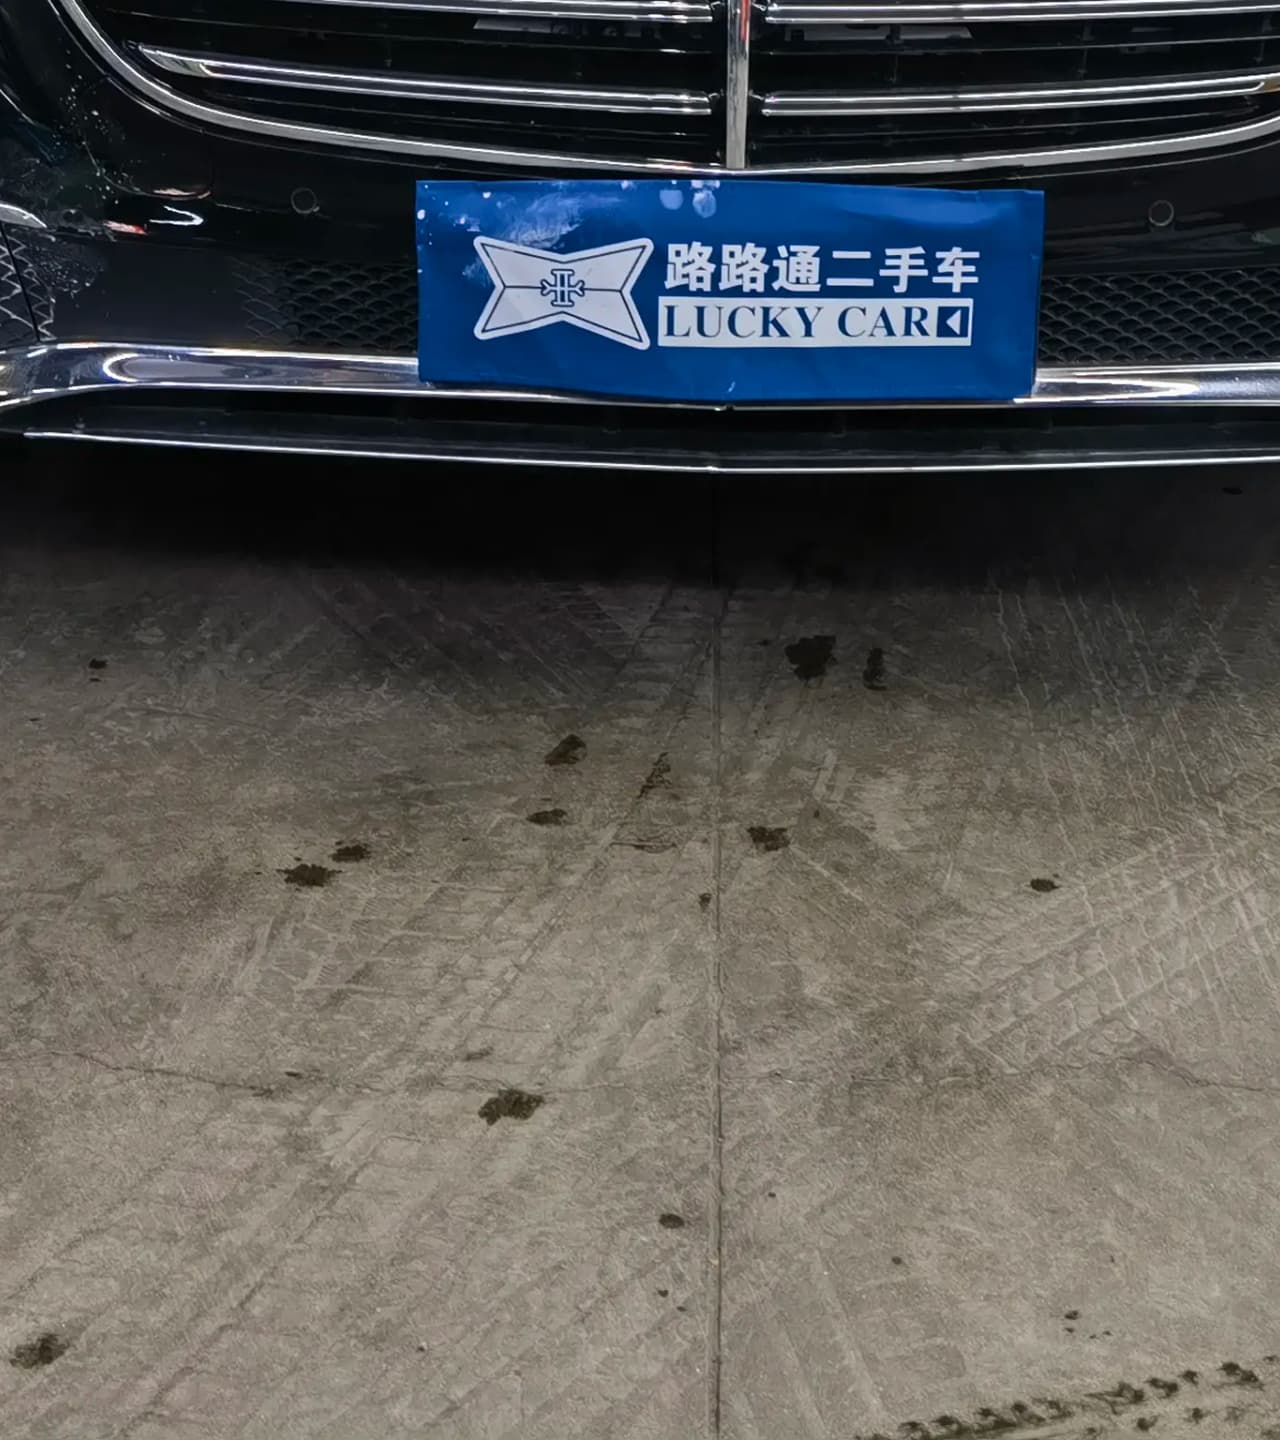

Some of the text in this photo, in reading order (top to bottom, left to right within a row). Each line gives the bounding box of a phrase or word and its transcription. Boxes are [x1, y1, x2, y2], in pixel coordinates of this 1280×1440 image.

[664, 241, 980, 294] 路路通二手车
[665, 304, 929, 339] LUCKY CAR
